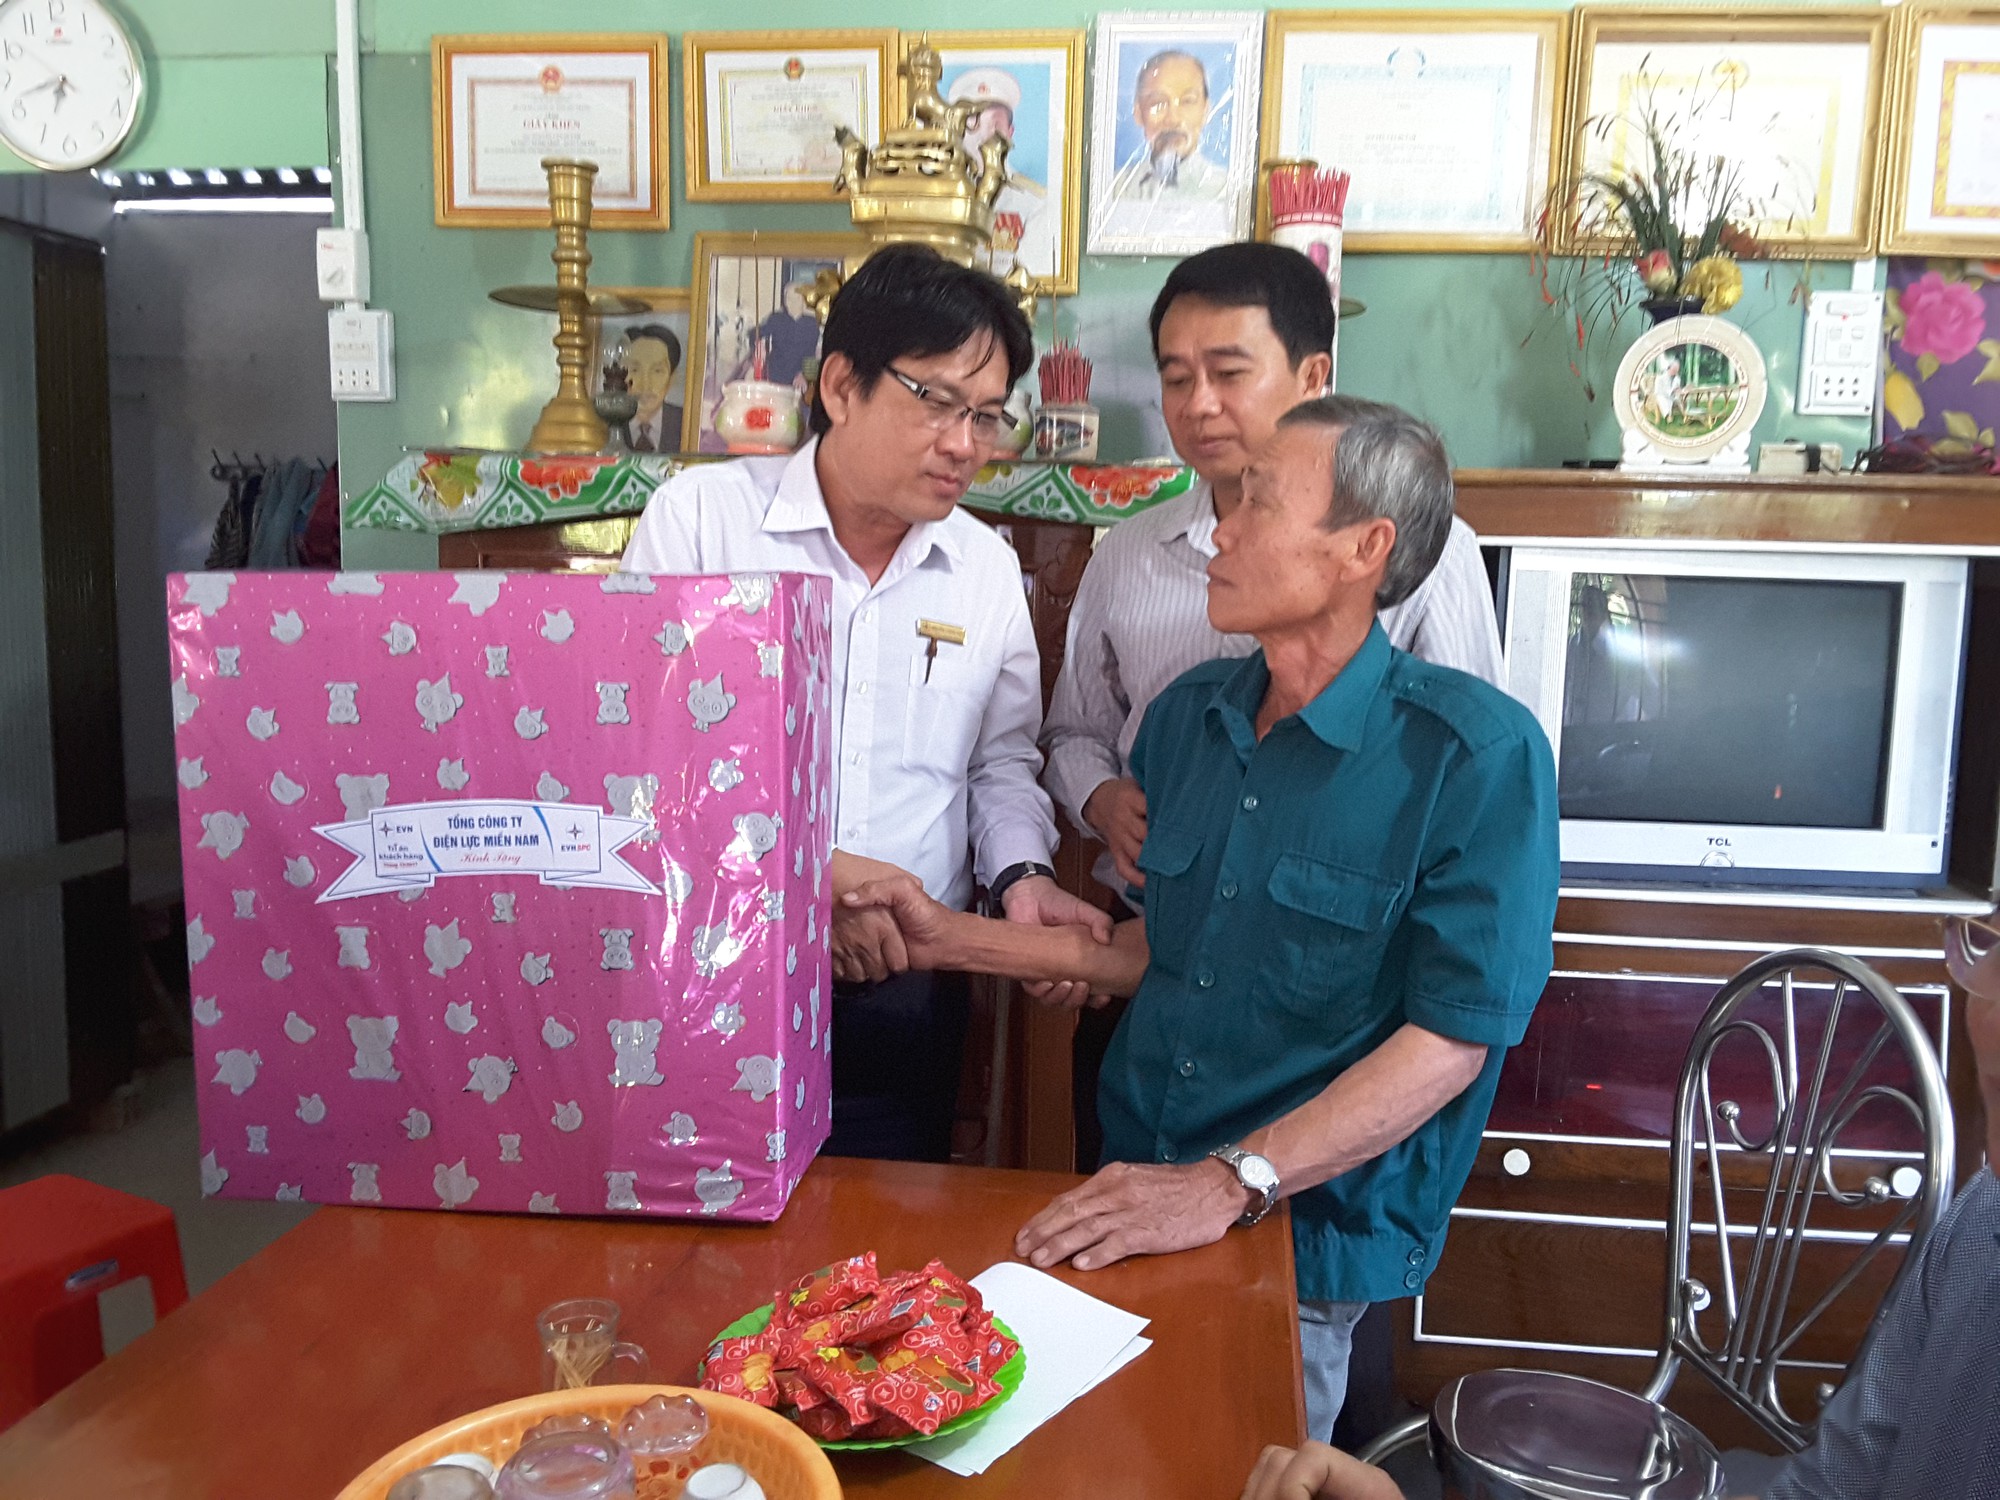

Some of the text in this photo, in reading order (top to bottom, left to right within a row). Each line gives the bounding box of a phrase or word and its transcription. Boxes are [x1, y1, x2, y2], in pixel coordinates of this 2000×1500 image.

[22, 12, 35, 35] 11
[4, 38, 23, 61] 10
[102, 33, 115, 58] 2
[12, 98, 27, 119] 8
[111, 97, 121, 119] 4
[62, 134, 78, 158] 6
[396, 825, 413, 833] EVN
[448, 813, 523, 829] TỔNG CÔNG TY
[433, 833, 458, 851] ĐIỆN
[461, 835, 480, 850] LỰC
[515, 835, 539, 846] NAM
[1706, 837, 1732, 847] TCL
